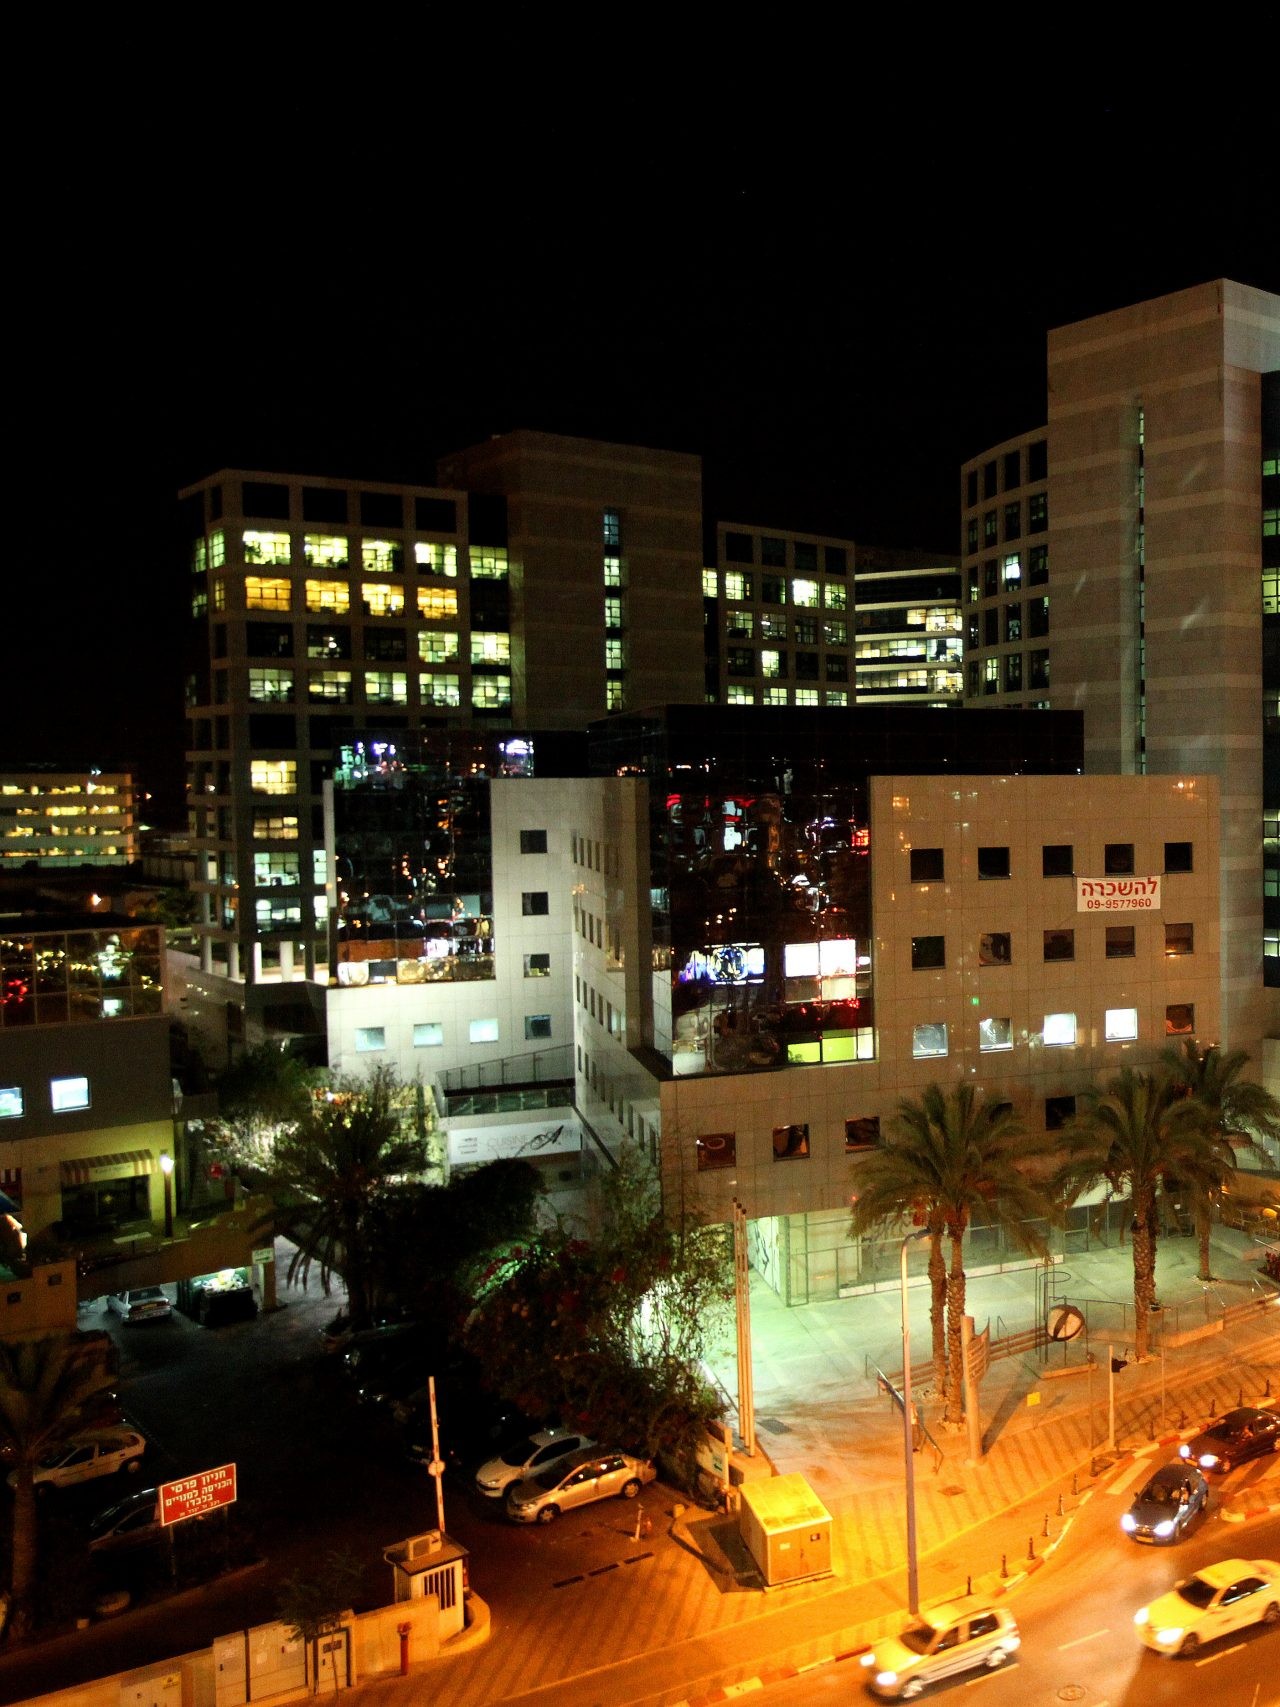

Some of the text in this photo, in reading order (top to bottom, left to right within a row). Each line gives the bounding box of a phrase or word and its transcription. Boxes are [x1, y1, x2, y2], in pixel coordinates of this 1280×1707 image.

[1081, 877, 1158, 896] להשכרה
[1087, 898, 1152, 909] 09-9577960
[201, 1470, 226, 1485] חניון
[166, 1479, 232, 1506] הכניסה למנויים
